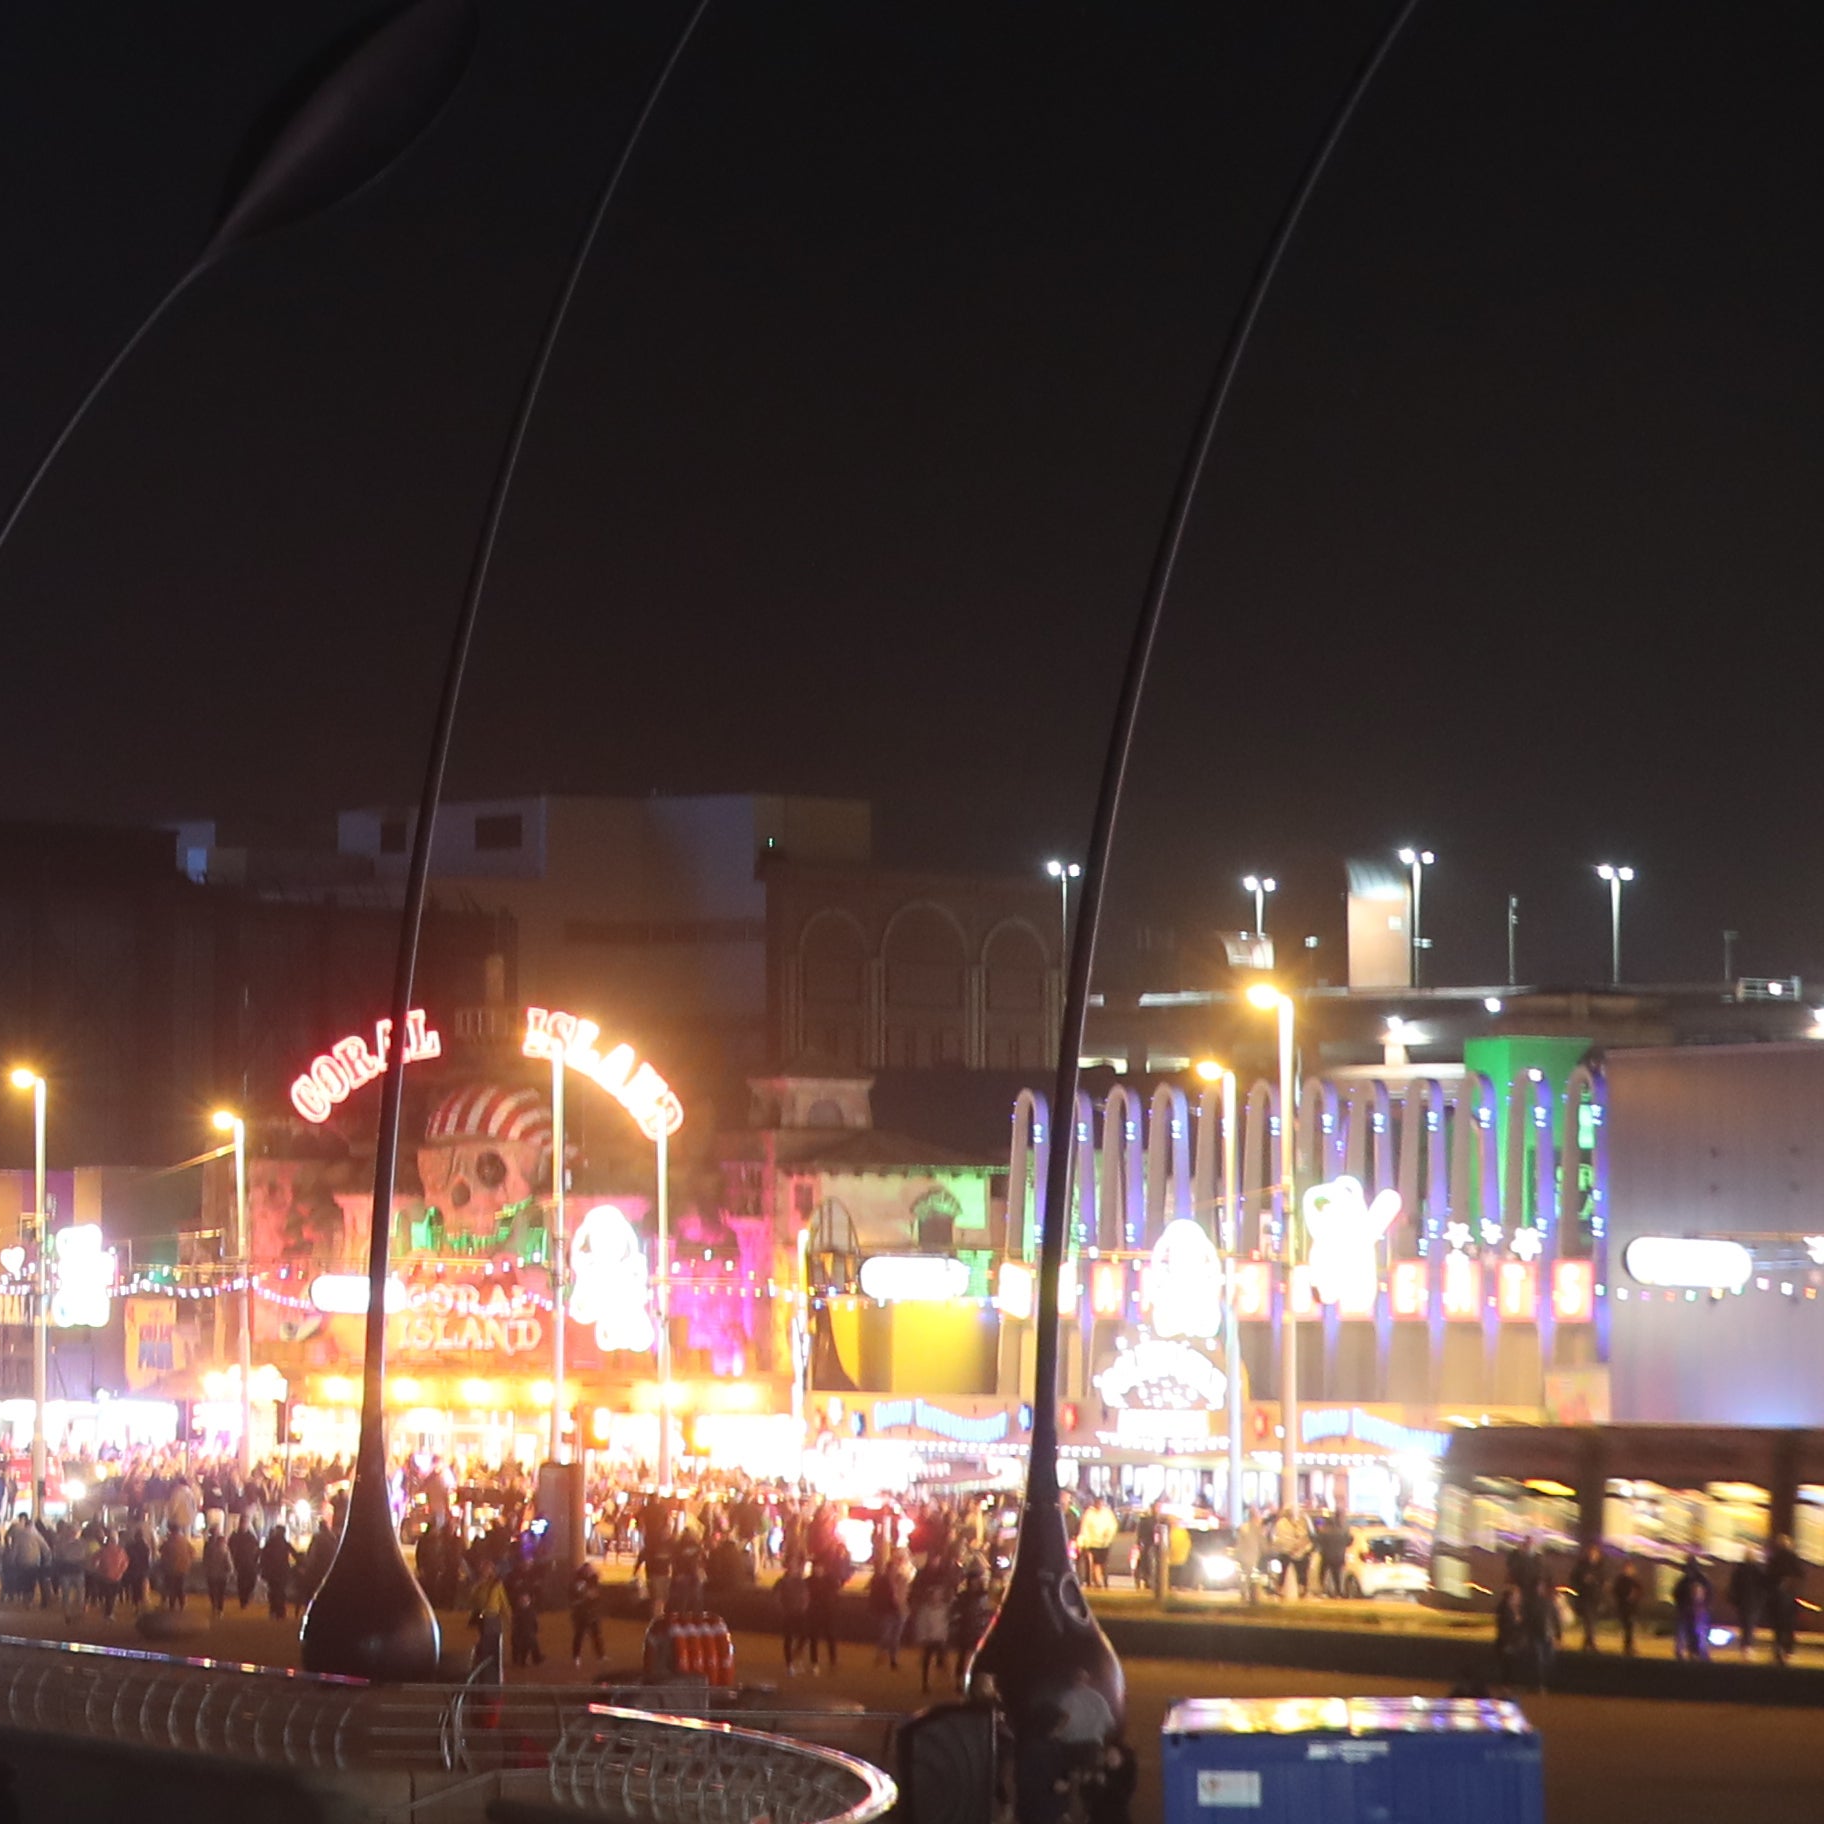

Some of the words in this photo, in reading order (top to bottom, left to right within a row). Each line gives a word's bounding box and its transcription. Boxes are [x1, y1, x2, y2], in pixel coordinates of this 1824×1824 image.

[521, 1006, 684, 1141] ISLAND
[404, 1283, 536, 1318] CORAL
[397, 1316, 542, 1355] ISLAND
